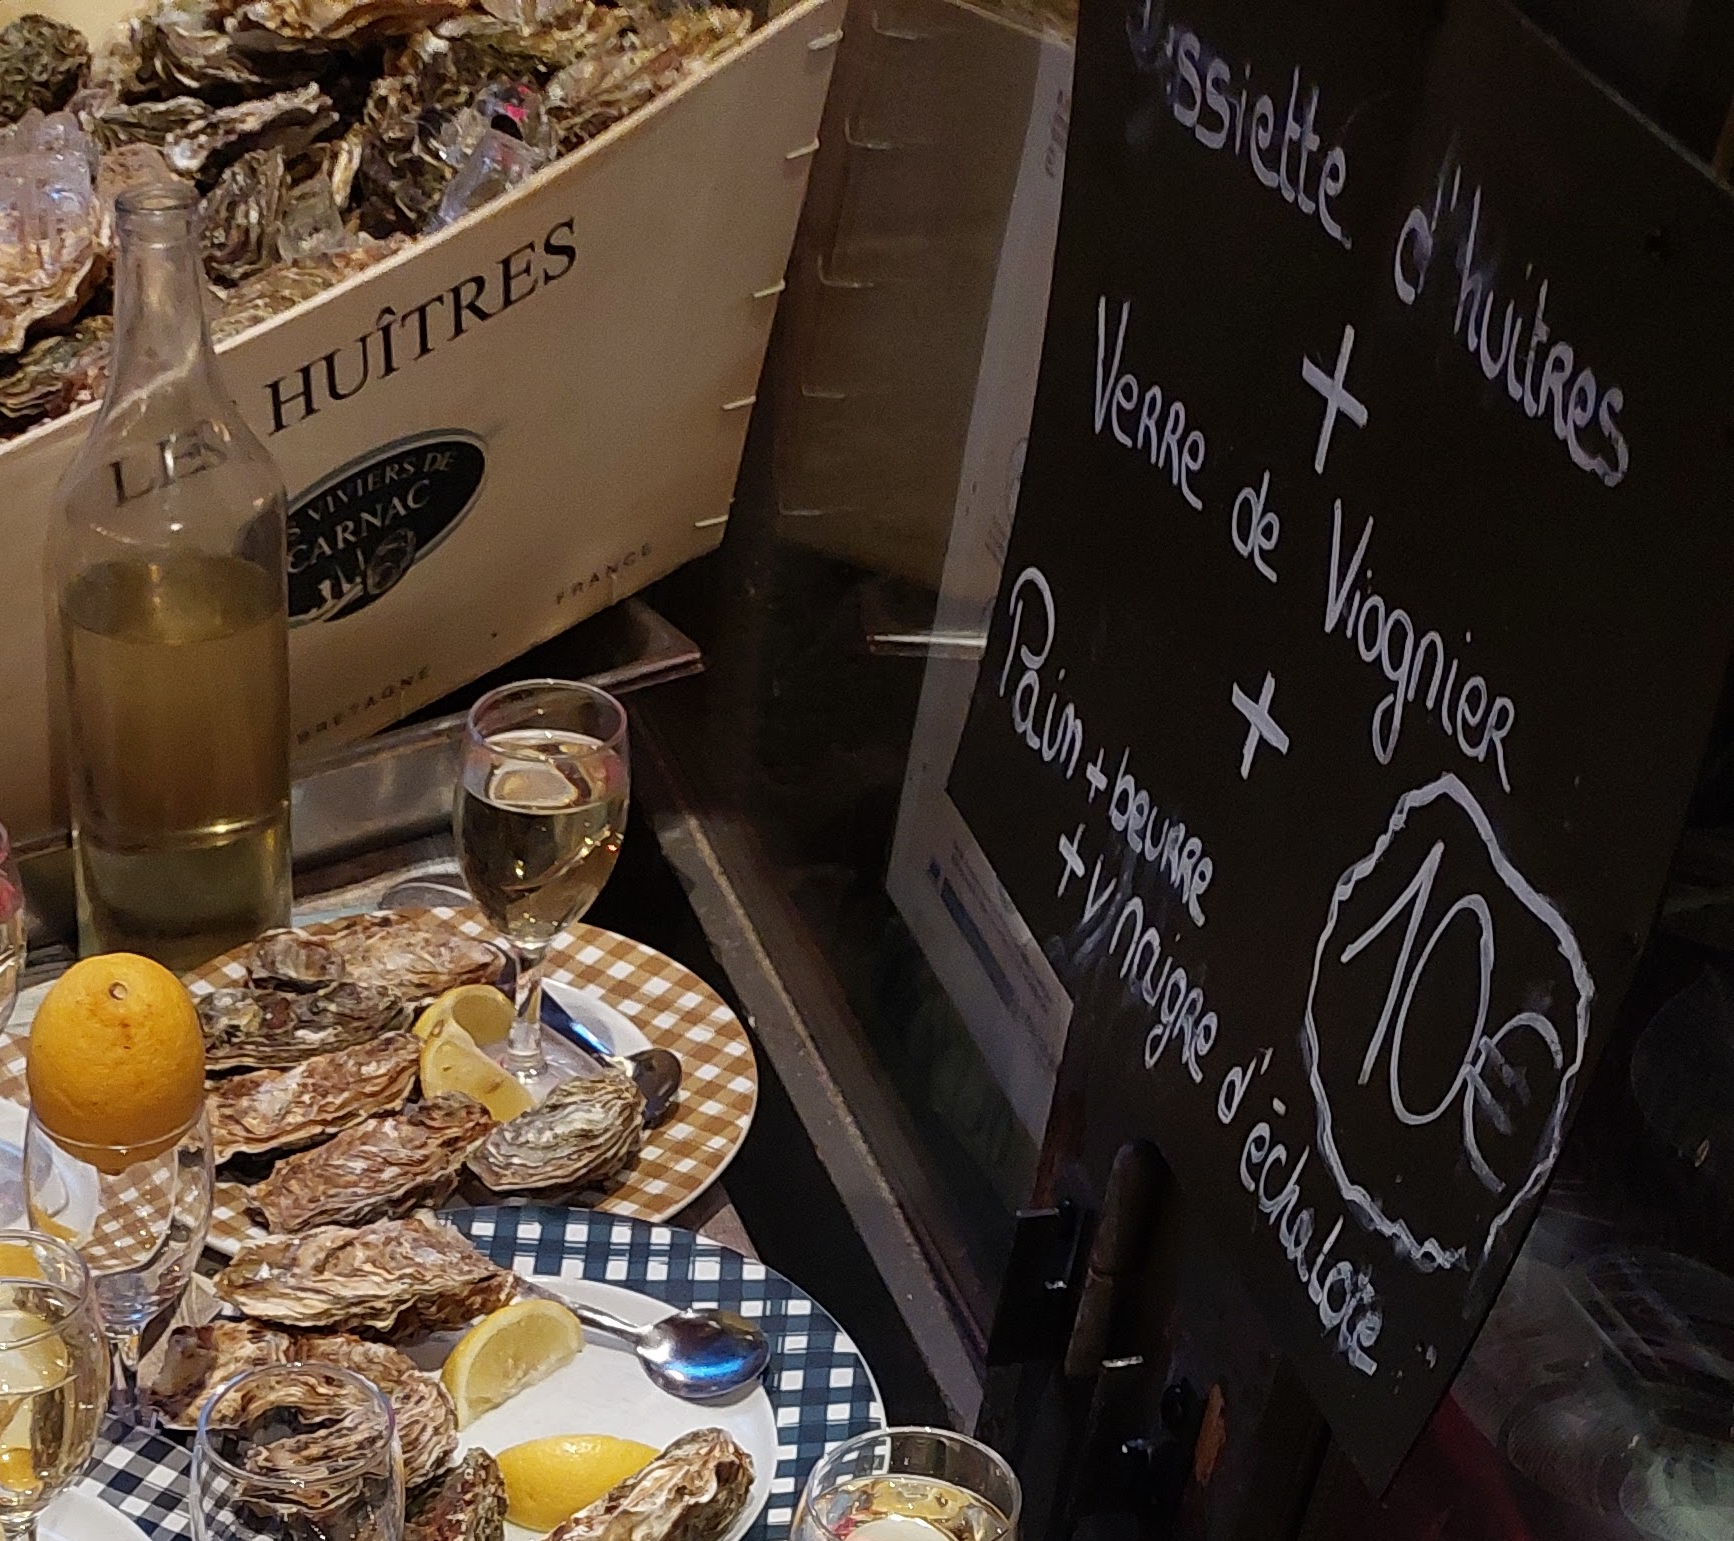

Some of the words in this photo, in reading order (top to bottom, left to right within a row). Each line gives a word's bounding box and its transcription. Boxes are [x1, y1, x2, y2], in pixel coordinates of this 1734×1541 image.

[1128, 0, 1352, 250] ssiette
[263, 216, 579, 436] HUÎTRES
[423, 451, 457, 473] DE
[287, 479, 430, 574] CARNAC
[555, 542, 654, 605] FRANCE
[1231, 469, 1278, 583] de
